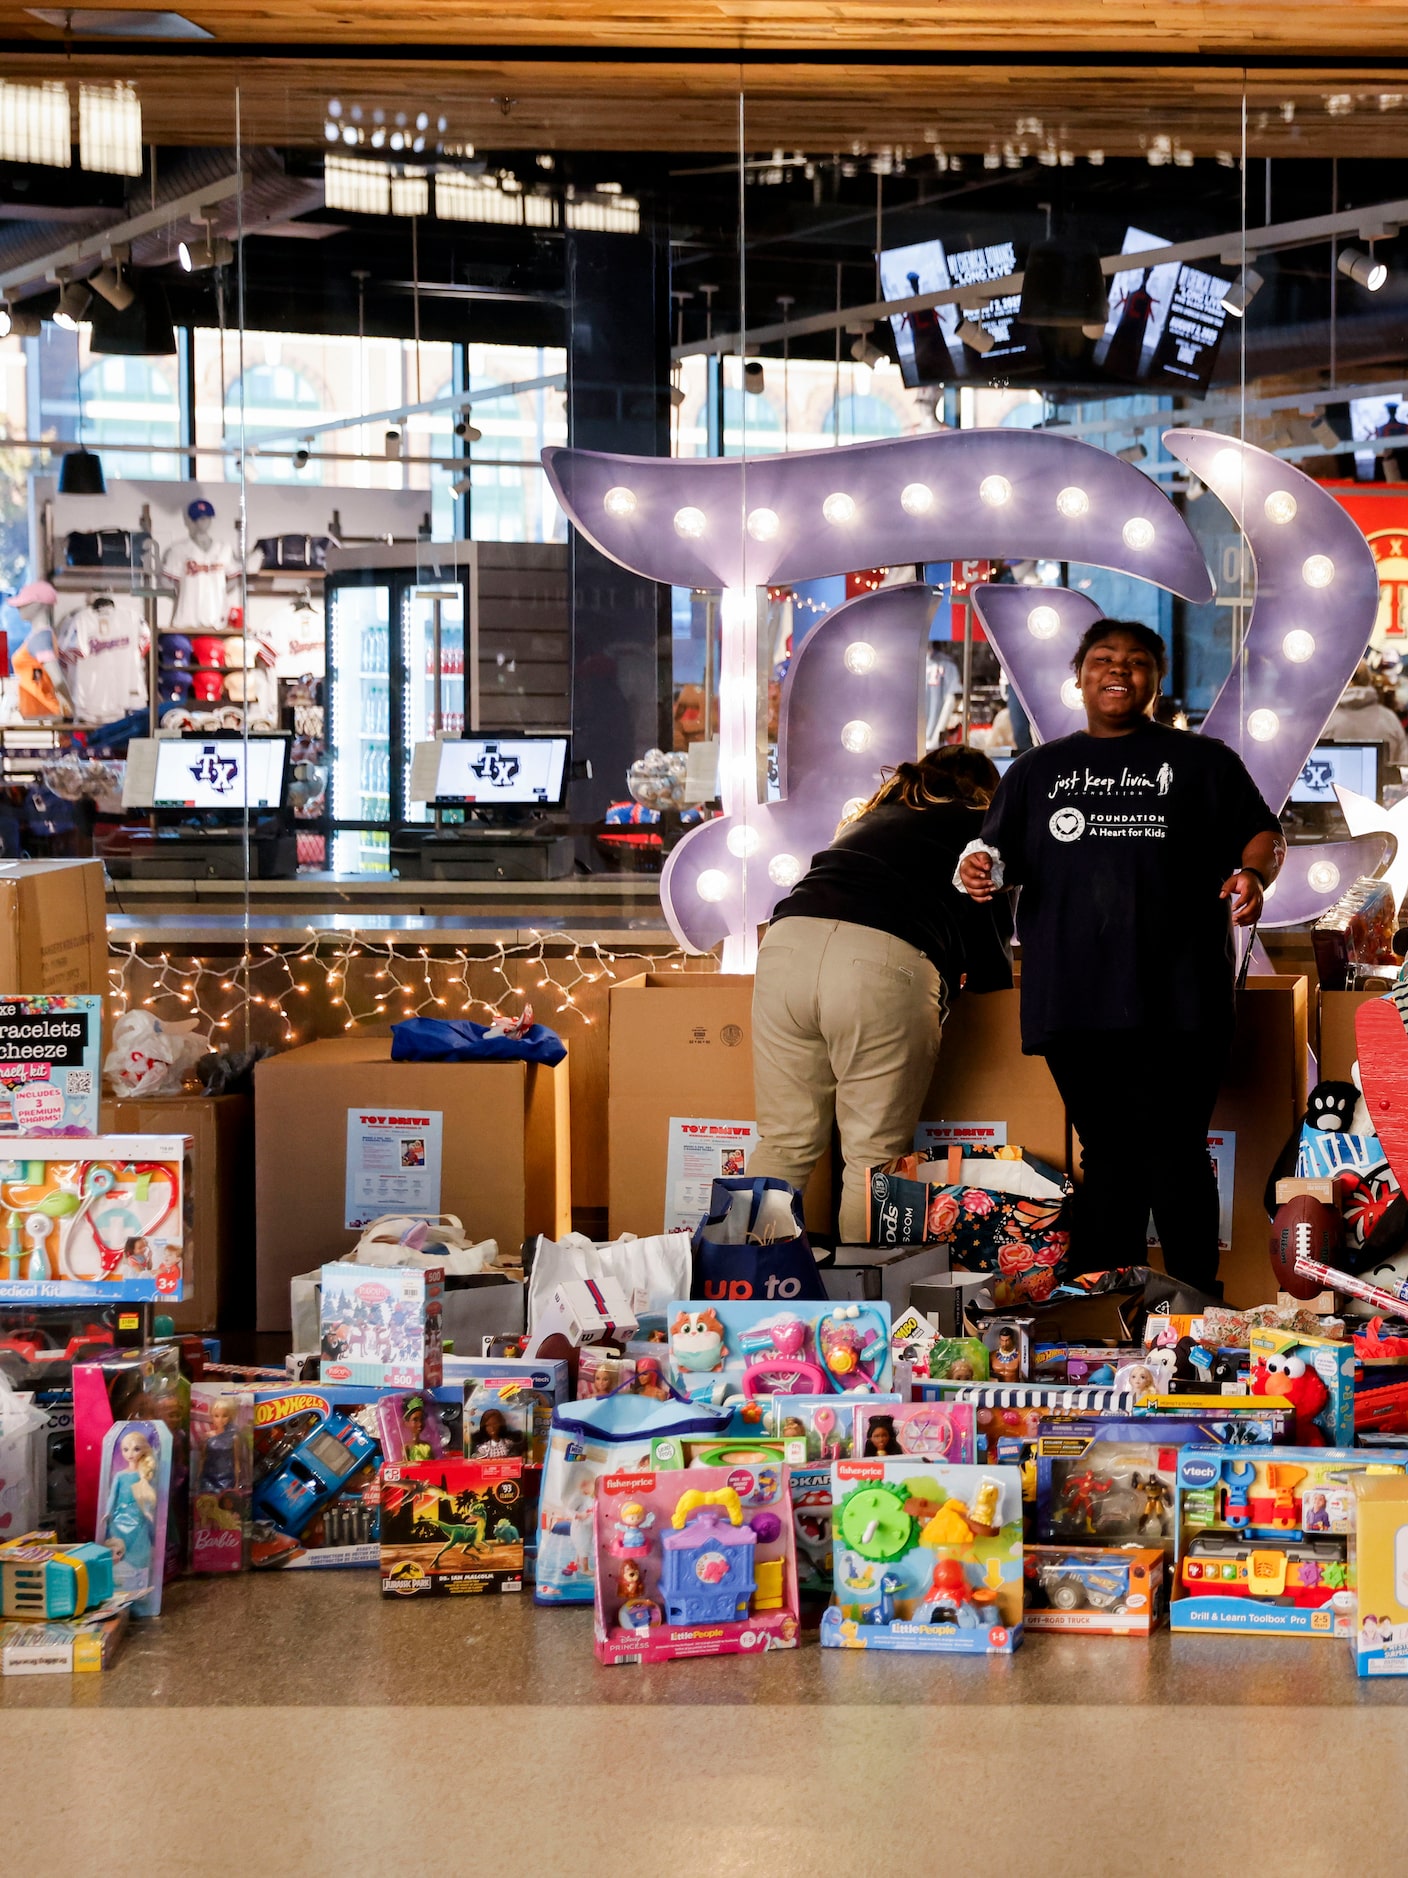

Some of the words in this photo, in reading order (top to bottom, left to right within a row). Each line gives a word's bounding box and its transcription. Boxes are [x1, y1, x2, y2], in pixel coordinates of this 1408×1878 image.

[1048, 770, 1080, 799] just
[1084, 768, 1115, 792] keep
[1120, 767, 1155, 787] livin
[1090, 814, 1165, 822] FOUNDATION
[1089, 828, 1097, 836] A
[1100, 828, 1126, 837] Heart
[1128, 828, 1142, 837] for
[1145, 828, 1165, 838] Kids
[29, 1065, 47, 1077] kit
[16, 1089, 61, 1100] INCLUDES
[36, 1100, 43, 1108] 3
[18, 1107, 61, 1117] PREMIUM
[19, 1114, 62, 1125] CHARMS!
[360, 1116, 387, 1124] TOY
[388, 1117, 430, 1126] DRIVE
[681, 1125, 707, 1133] TOY
[709, 1126, 751, 1136] DRIVE
[926, 1129, 951, 1137] TOY
[428, 1271, 441, 1282] 500
[158, 1278, 175, 1290] 3+
[704, 1279, 754, 1300] up
[764, 1274, 801, 1299] to
[41, 1284, 60, 1296] Kit
[394, 1375, 412, 1384] 500
[658, 1445, 671, 1453] Leap
[659, 1450, 672, 1458] Frog
[839, 1466, 883, 1476] fisher-price
[1183, 1467, 1215, 1477] vtech
[606, 1477, 653, 1489] fisher-price
[195, 1530, 240, 1549] Barbie
[464, 1573, 494, 1581] MALCOLM
[385, 1579, 411, 1589] JURASSIC
[412, 1578, 429, 1588] PARK
[1190, 1612, 1209, 1621] Drill
[1212, 1613, 1217, 1621] &
[1220, 1614, 1246, 1622] Learn
[1249, 1614, 1285, 1623] Toolbox
[1290, 1616, 1306, 1624] Pro
[1314, 1615, 1328, 1623] 2-5
[992, 1632, 1005, 1641] 1-5
[610, 1642, 650, 1651] PRINCESS
